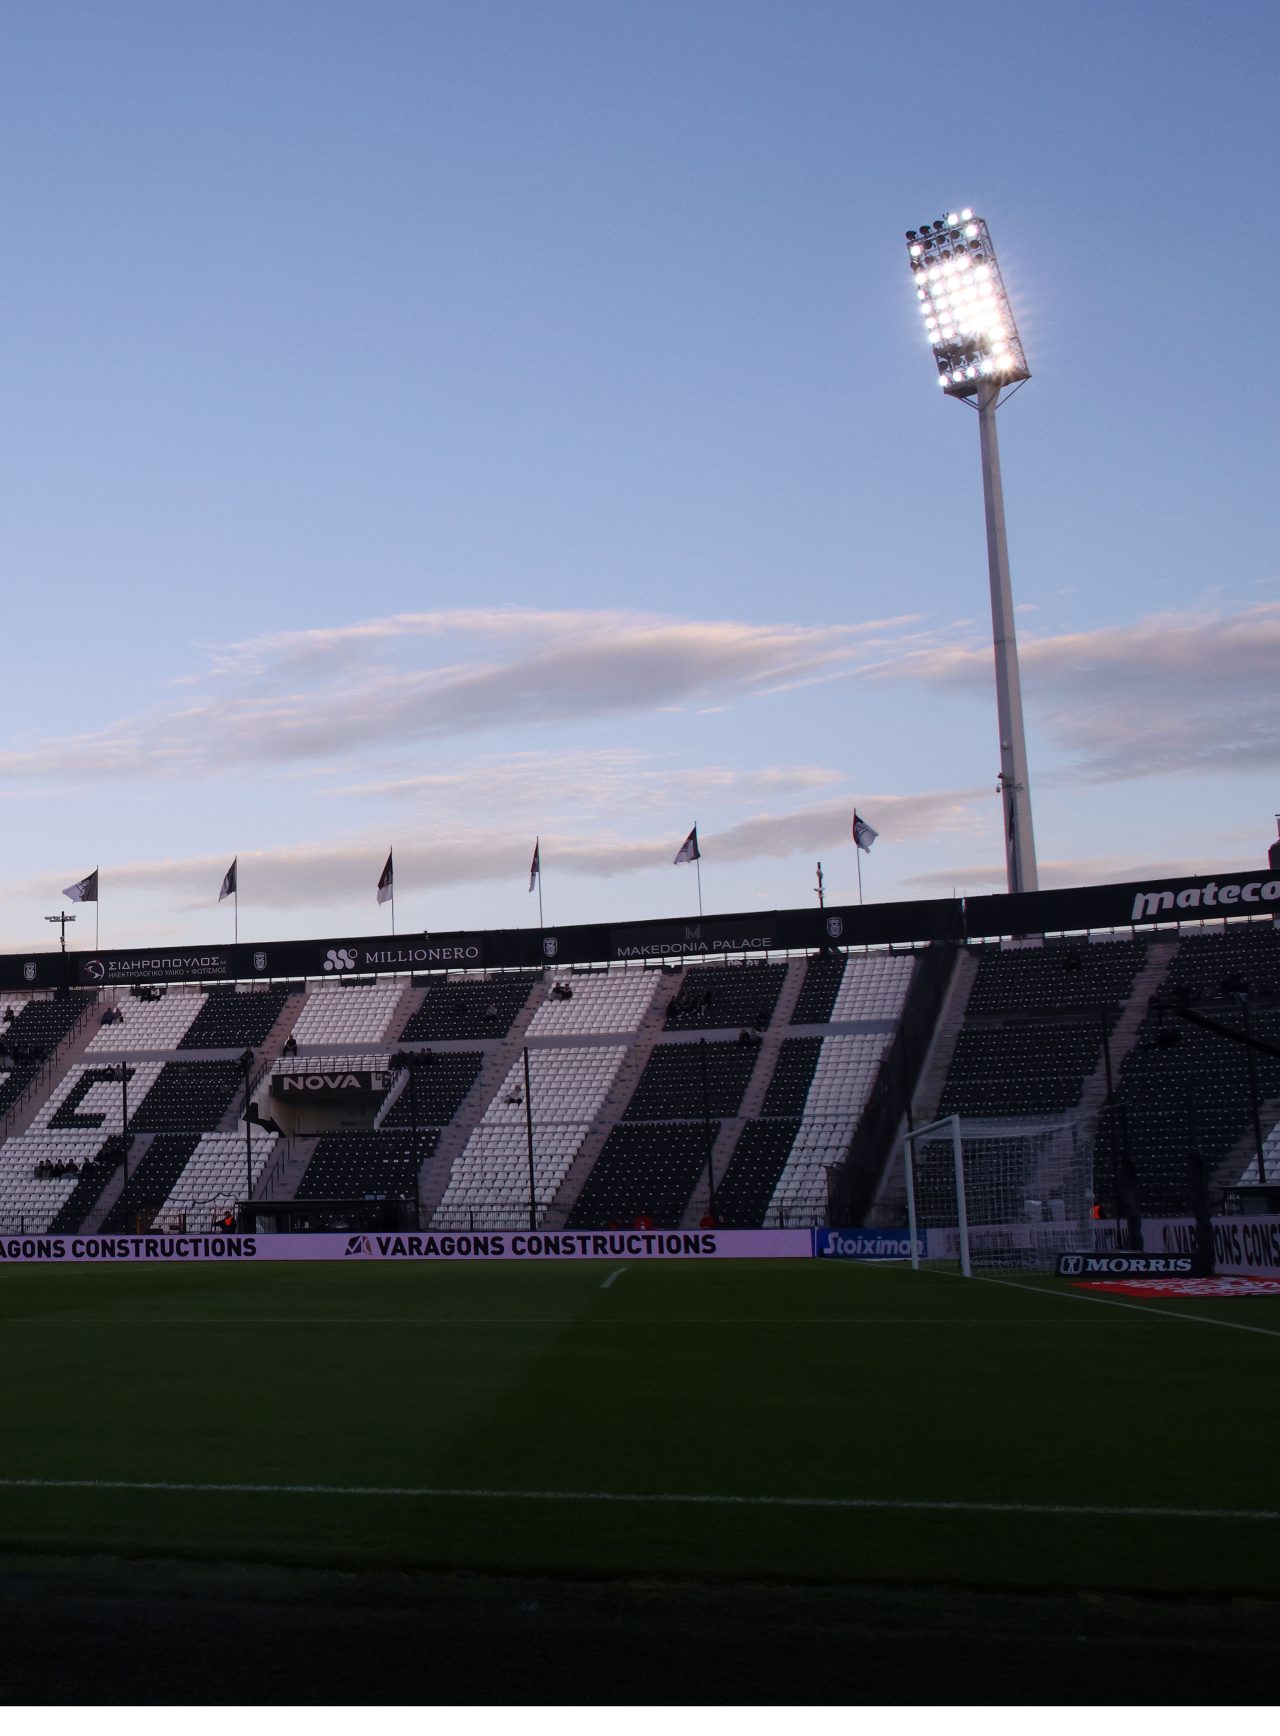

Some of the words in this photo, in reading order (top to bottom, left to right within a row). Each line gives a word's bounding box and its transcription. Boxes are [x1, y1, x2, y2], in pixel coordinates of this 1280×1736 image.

[1131, 880, 1280, 921] mateco
[365, 946, 479, 964] MILLIONERO
[617, 942, 709, 957] MAKEDONIA
[712, 937, 772, 950] PALACE
[108, 956, 220, 971] ΣΙΔΗΡΟΠΟΥΛΟΣ
[282, 1073, 362, 1091] NOVA
[71, 1237, 257, 1258] CONSTRUCTIONS
[376, 1236, 505, 1256] VARAGONS
[511, 1234, 717, 1255] CONSTRUCTIONS
[1085, 1257, 1192, 1273] MORRIS
